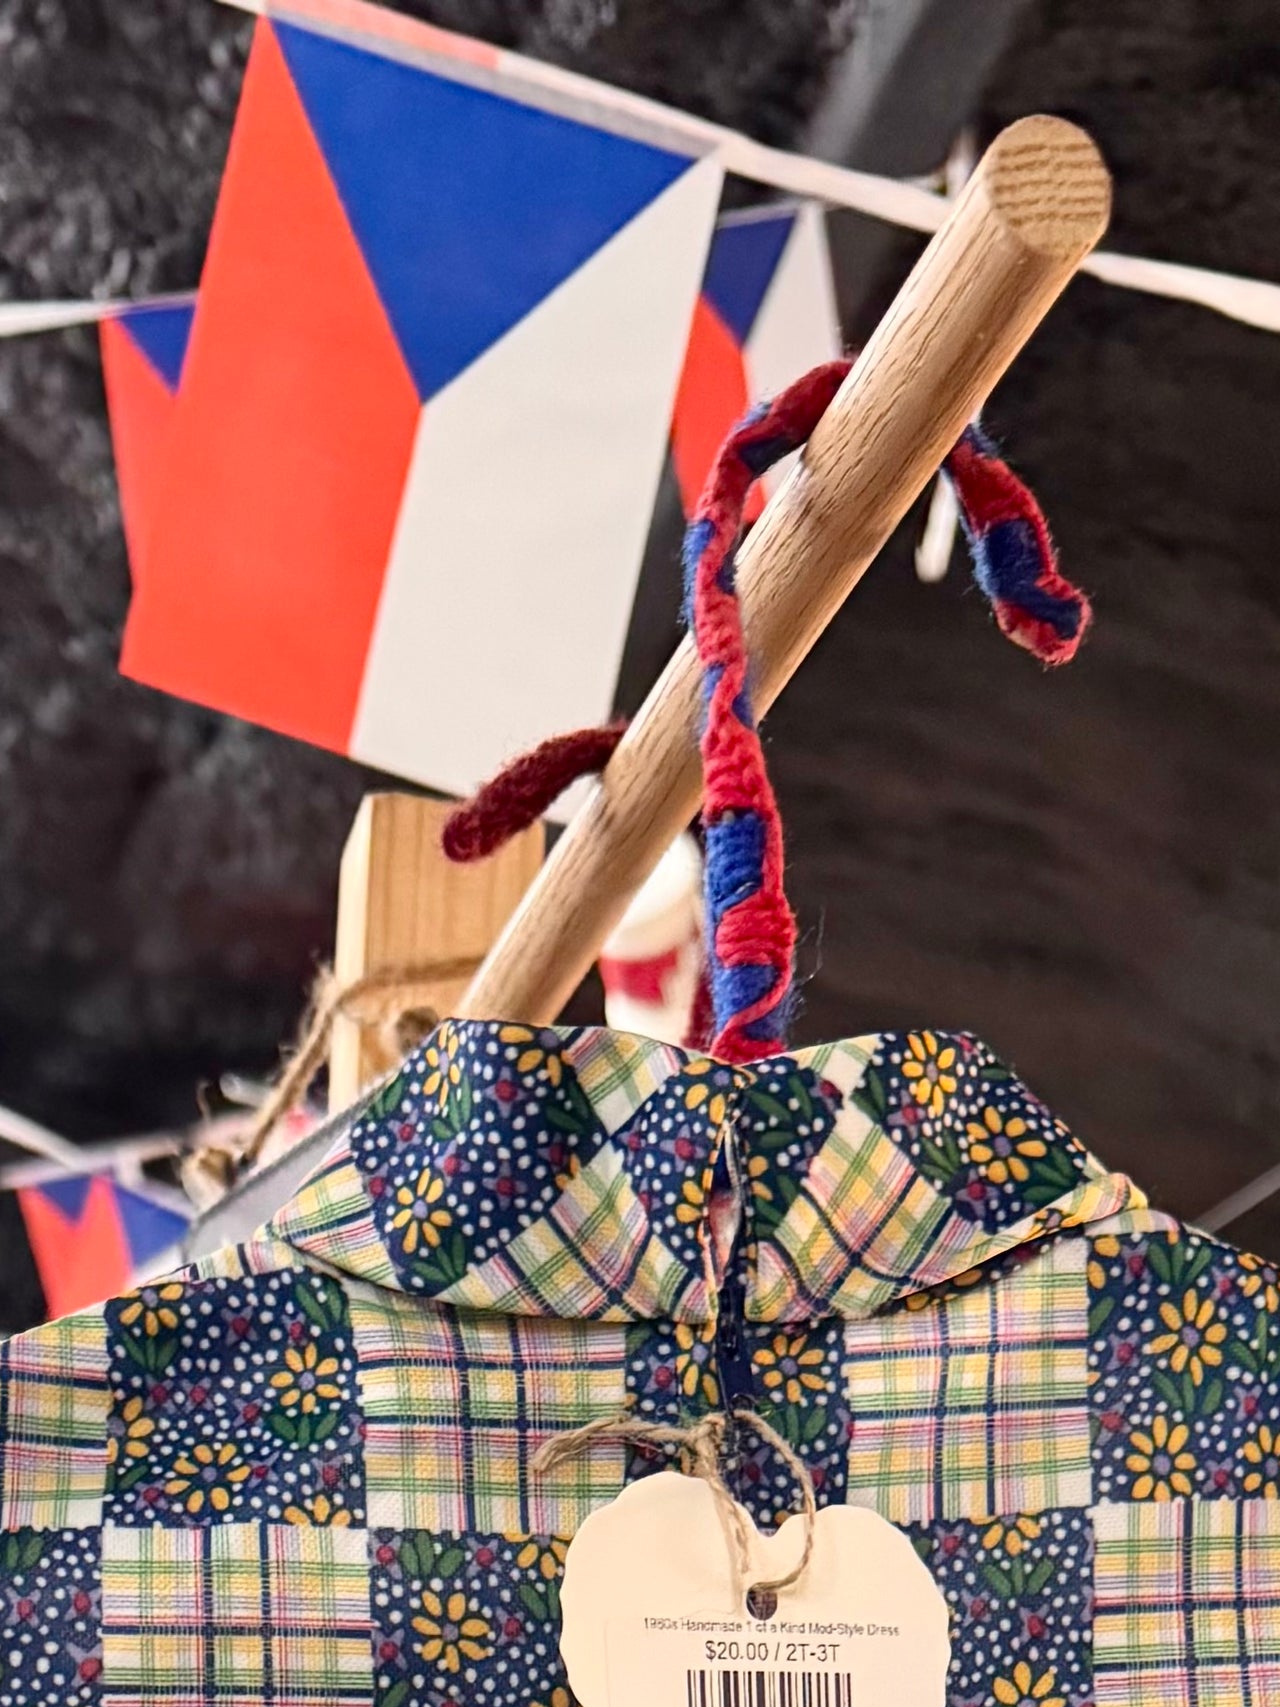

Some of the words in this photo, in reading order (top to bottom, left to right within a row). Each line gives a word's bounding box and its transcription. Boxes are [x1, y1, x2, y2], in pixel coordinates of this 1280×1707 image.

[681, 1618, 743, 1633] Handmade
[746, 1620, 752, 1633] 1
[755, 1621, 768, 1634] of
[770, 1624, 777, 1634] a
[780, 1621, 806, 1634] Kind
[808, 1622, 864, 1638] Mod-Style
[867, 1623, 900, 1637] Dress
[704, 1640, 769, 1662] $20.00
[773, 1641, 781, 1662] /
[786, 1643, 841, 1662] 2T-3T
